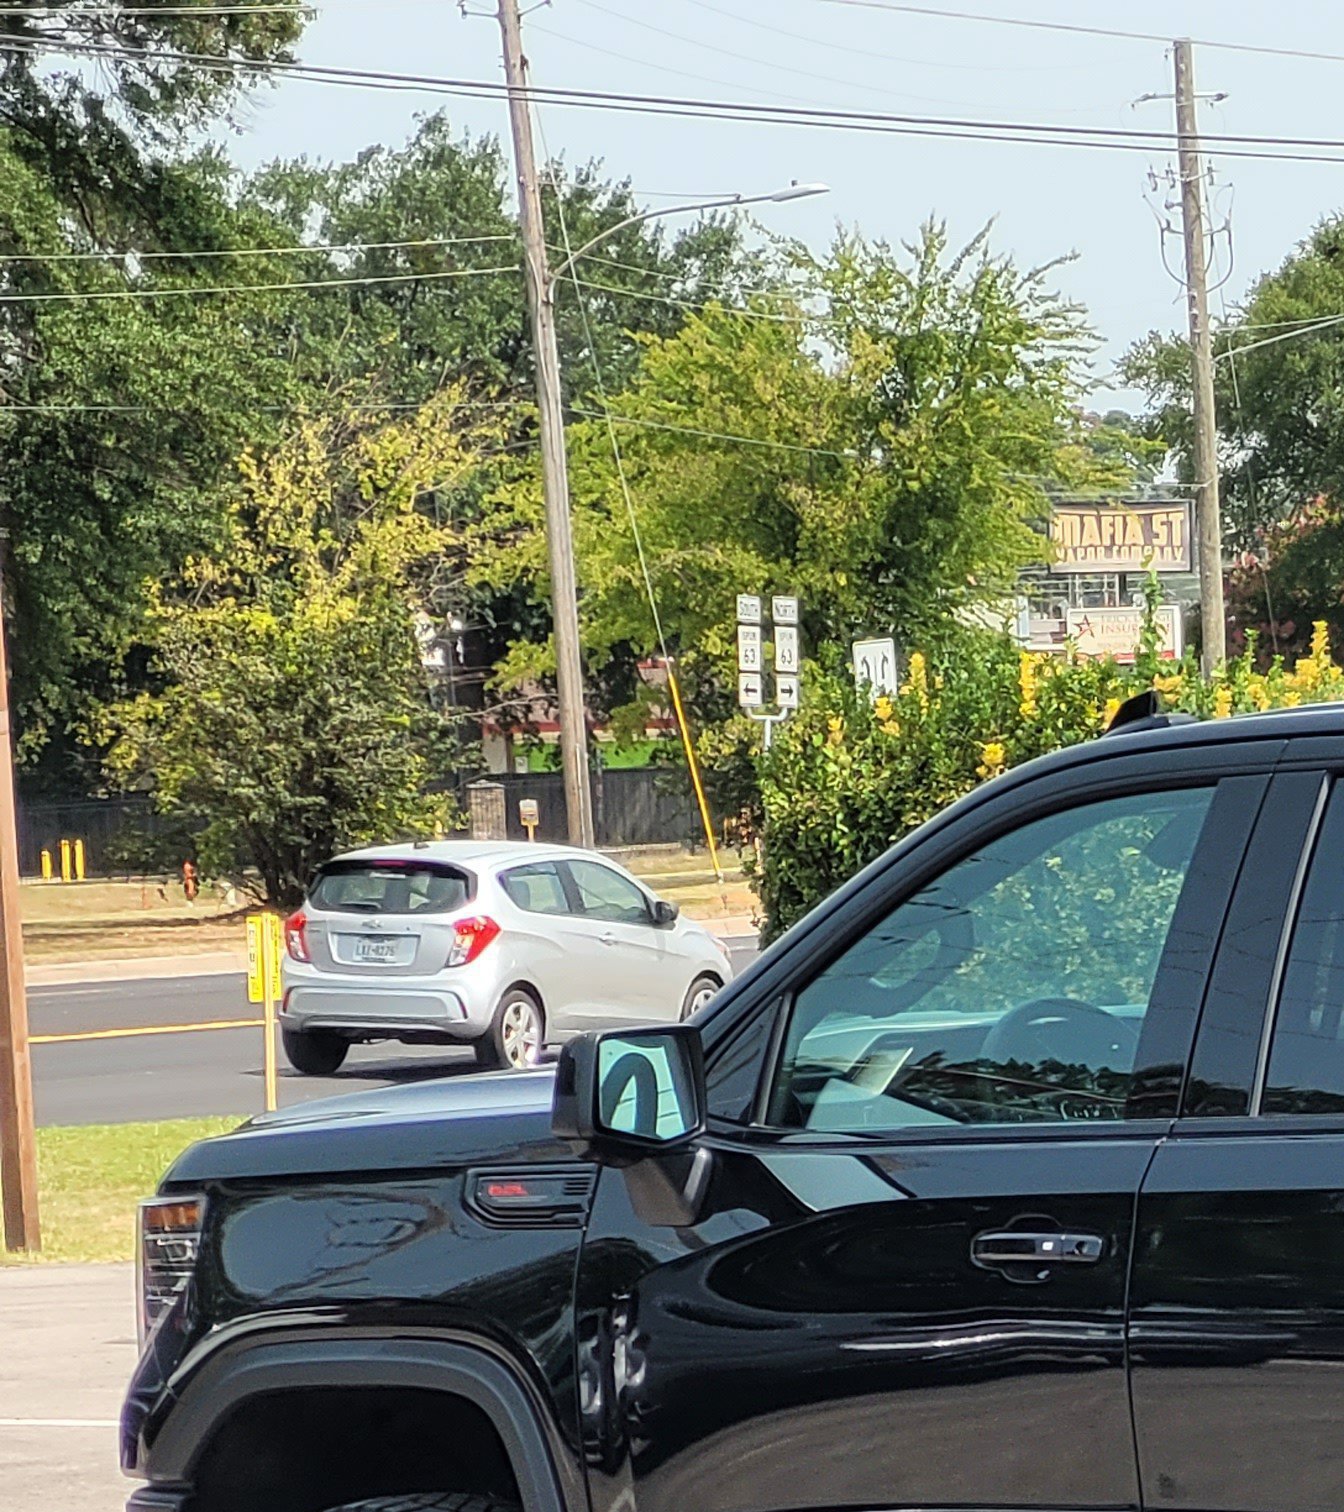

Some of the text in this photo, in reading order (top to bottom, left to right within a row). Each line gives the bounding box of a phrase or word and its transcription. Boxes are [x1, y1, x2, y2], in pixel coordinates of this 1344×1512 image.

[1053, 511, 1185, 547] MAFIA ST
[744, 648, 756, 663] 63
[780, 649, 793, 664] 63
